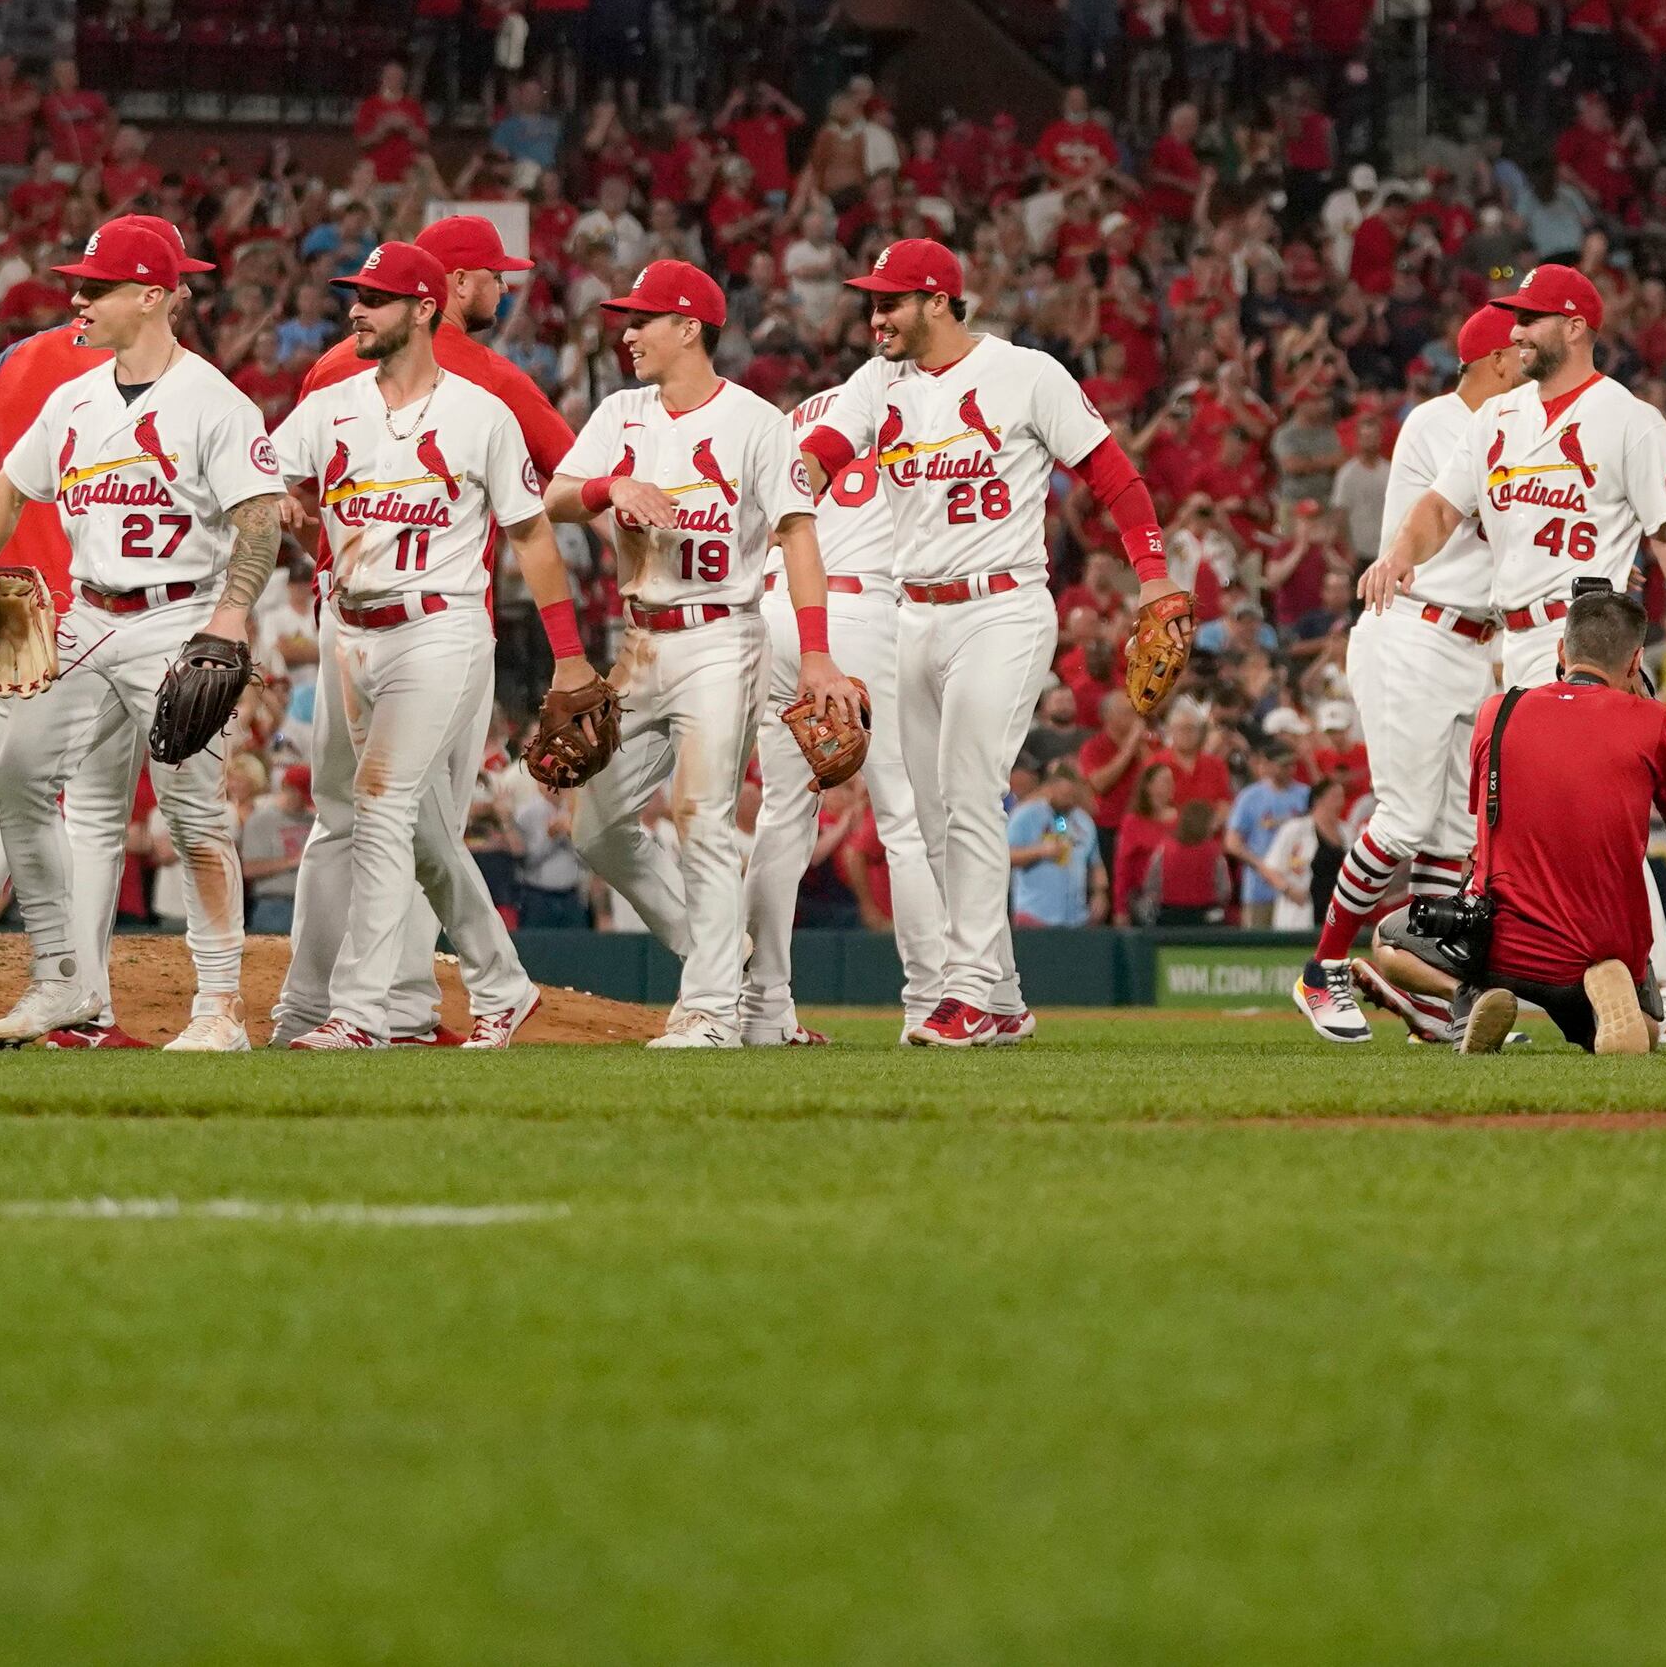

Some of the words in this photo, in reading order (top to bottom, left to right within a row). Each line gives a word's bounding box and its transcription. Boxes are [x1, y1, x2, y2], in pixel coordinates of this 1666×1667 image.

[888, 443, 997, 488] Cadinals
[332, 478, 452, 528] Cardinals
[947, 479, 1013, 525] 28
[121, 513, 193, 559] 27
[395, 529, 430, 571] 11
[1533, 517, 1599, 562] 46
[679, 538, 730, 583] 19
